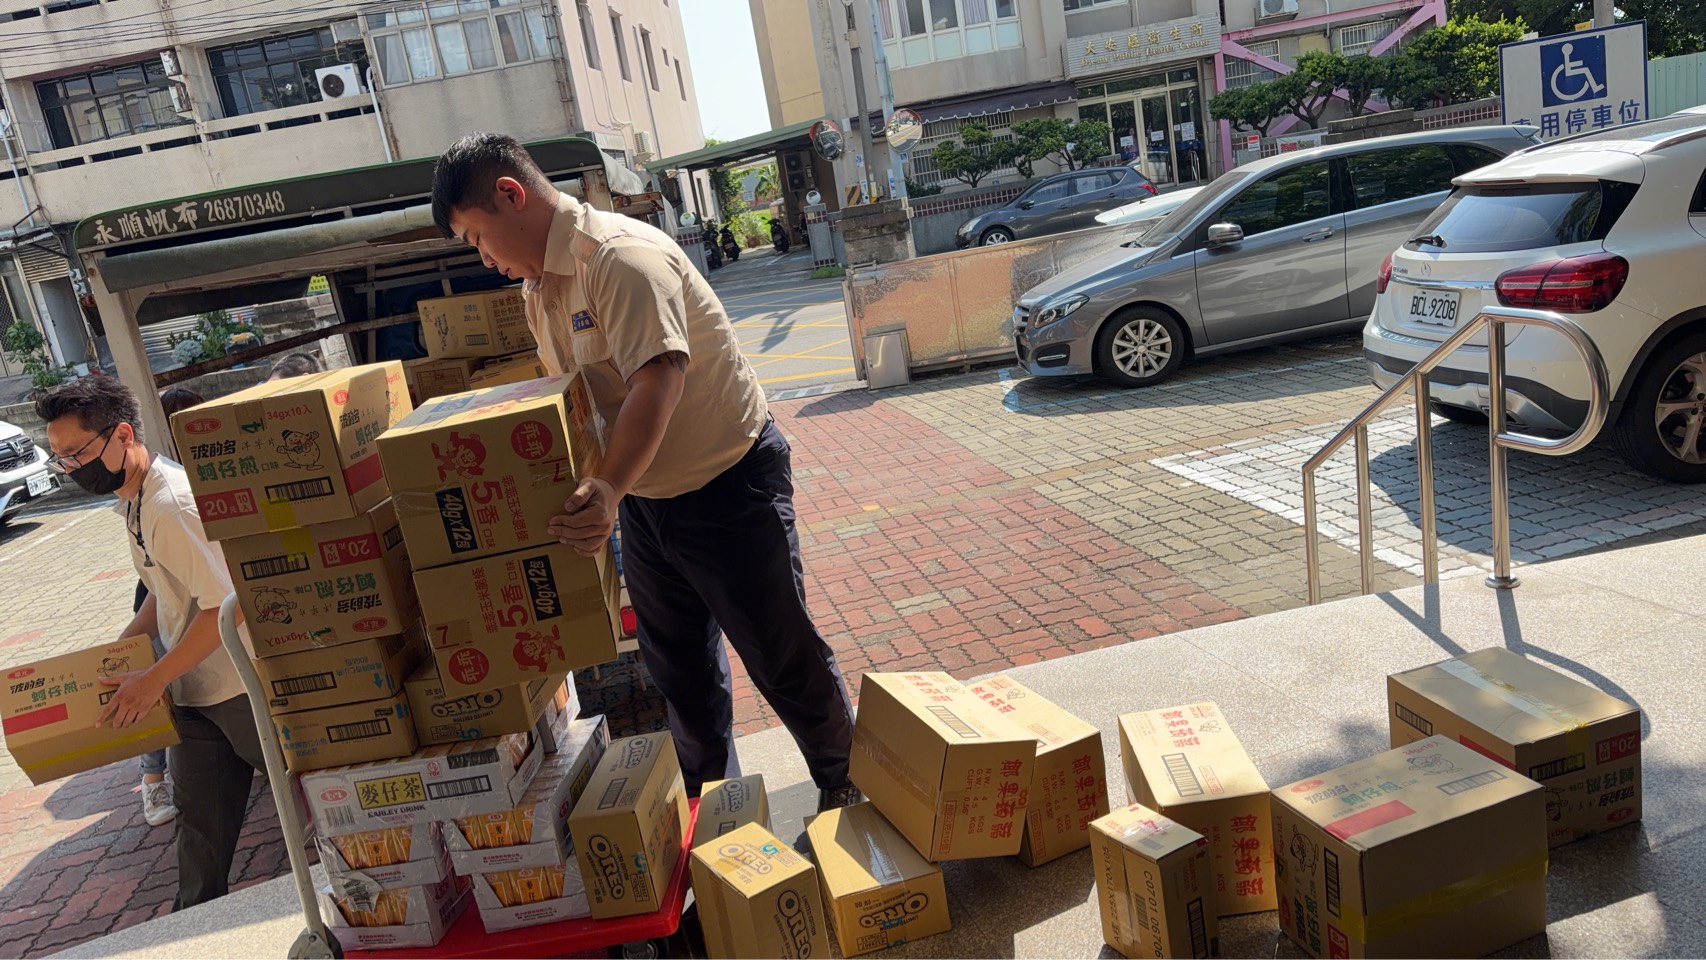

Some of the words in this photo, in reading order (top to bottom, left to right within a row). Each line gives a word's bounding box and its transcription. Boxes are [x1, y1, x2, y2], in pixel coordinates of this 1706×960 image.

[1113, 50, 1139, 61] Public
[1145, 44, 1174, 57] Health
[1179, 38, 1210, 50] Center
[93, 201, 198, 246] 永順帆布
[203, 190, 286, 223] 26870348
[266, 404, 313, 421] 34gx10入
[190, 439, 237, 460] 波的多
[520, 423, 545, 458] 乖乖
[195, 455, 260, 482] 蚵仔煎
[262, 462, 280, 472] 口味
[314, 572, 378, 600] 蚵仔煎
[337, 594, 383, 614] 波的多
[457, 651, 481, 683] 乖乖
[10, 677, 46, 695] 波的多
[31, 680, 79, 703] 蚵仔煎
[431, 689, 502, 718] OREO
[625, 737, 648, 770] OREO
[361, 777, 422, 807] 麥仔茶
[724, 780, 743, 813] OREO
[400, 804, 426, 813] DRINK
[968, 816, 976, 835] KGS
[977, 815, 985, 834] KGS
[1056, 817, 1064, 834] KGS
[588, 834, 625, 900] OREO
[718, 843, 772, 875] OREO
[1217, 873, 1225, 892] KGS
[860, 892, 929, 928] OREO
[1144, 870, 1158, 913] C0701
[1151, 917, 1163, 959] 06706
[777, 889, 812, 960] OREO
